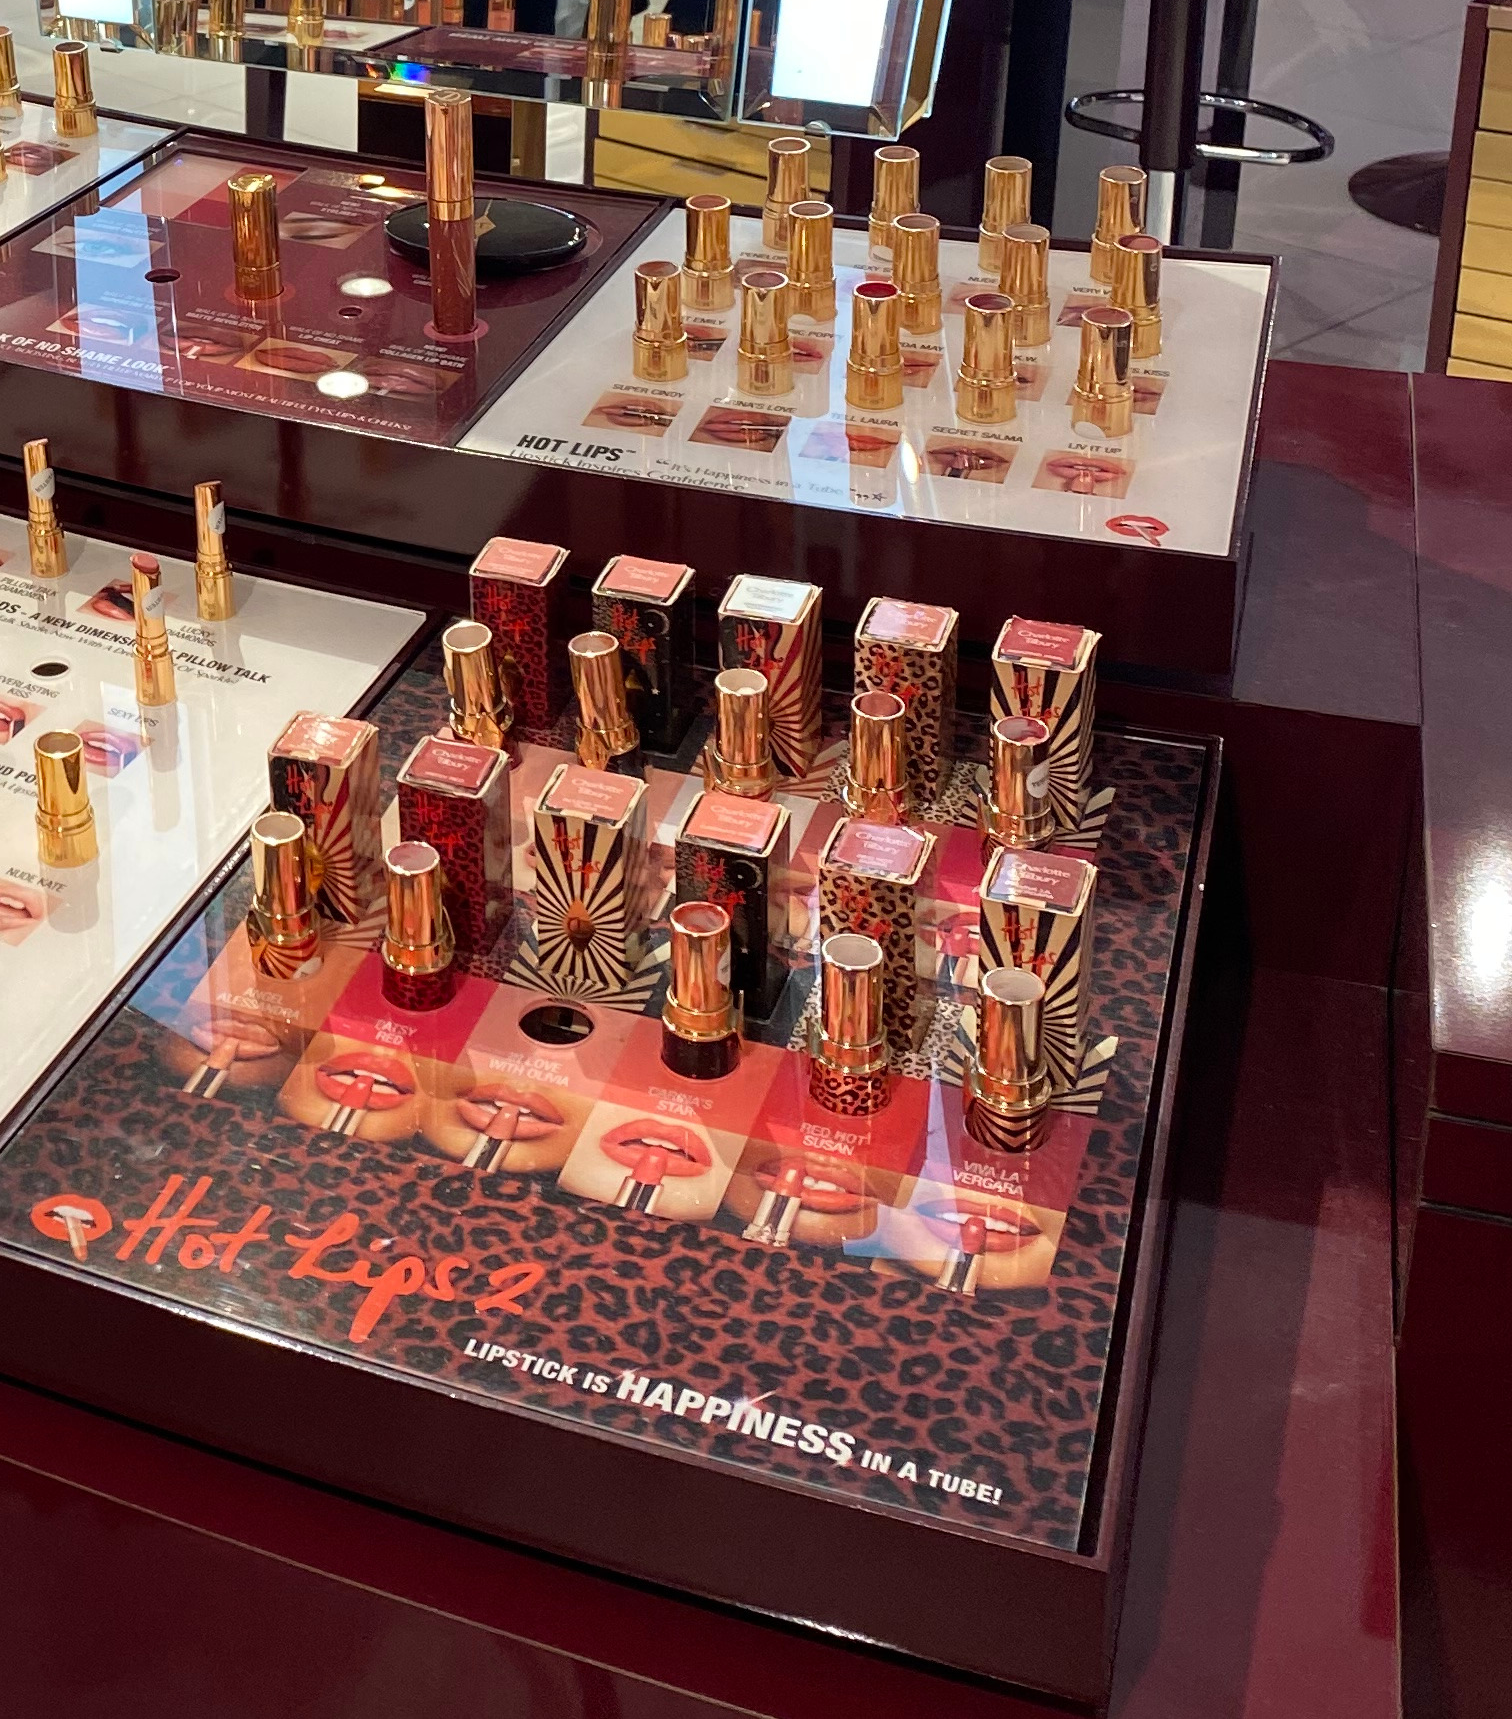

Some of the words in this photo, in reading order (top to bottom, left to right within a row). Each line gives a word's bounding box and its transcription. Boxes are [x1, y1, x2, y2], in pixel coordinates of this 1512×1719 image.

[14, 335, 37, 348] OF
[37, 340, 62, 354] NO
[61, 344, 122, 365] SHAME
[612, 383, 648, 394] SUPER
[649, 387, 686, 399] CINDY
[766, 404, 798, 415] LOVE
[860, 415, 900, 428] LAURA
[932, 425, 979, 438] SECRET
[981, 430, 1024, 443] SALMA
[517, 434, 568, 454] HOT
[572, 441, 624, 462] LIPS
[1068, 442, 1087, 452] LIV
[1104, 446, 1123, 455] UP
[576, 457, 642, 478] Inspires
[647, 468, 746, 492] Confidence
[694, 465, 772, 486] Happiness
[0, 576, 33, 592] PILLOW
[32, 584, 60, 597] TALK
[179, 623, 214, 638] LUCKY
[1017, 629, 1071, 644] Charlotte
[42, 613, 77, 632] NEW
[176, 649, 237, 677] PILLOW
[235, 665, 271, 685] TALK
[7, 687, 32, 700] KISS
[107, 707, 140, 723] SEXY
[431, 746, 482, 764] Charlotte
[426, 822, 466, 861] Lips
[5, 866, 38, 884] NUDE
[35, 875, 69, 894] KATE
[215, 991, 300, 1021] ALESSANDRA
[243, 987, 284, 1005] ANGEL
[373, 1018, 418, 1037] PATSY
[374, 1029, 405, 1045] RED
[489, 1058, 520, 1077] WITH
[518, 1065, 570, 1088] OLIVIA
[523, 1055, 564, 1072] LOVE
[647, 1086, 715, 1111] CARINA'S
[655, 1099, 697, 1118] STAR
[801, 1121, 833, 1142] RED
[802, 1134, 855, 1157] SUSAN
[963, 1159, 998, 1181] VIVA
[999, 1169, 1021, 1184] LA
[952, 1171, 1026, 1197] VERGARA
[115, 1174, 273, 1274] Hot
[285, 1211, 470, 1344] Lips
[474, 1262, 547, 1316] 2
[464, 1338, 577, 1386] LIPSTICK
[582, 1371, 610, 1395] IS
[614, 1369, 857, 1468] HAPPINESS
[860, 1449, 894, 1475] IN
[896, 1460, 920, 1484] A
[928, 1468, 1005, 1506] TUBE!
